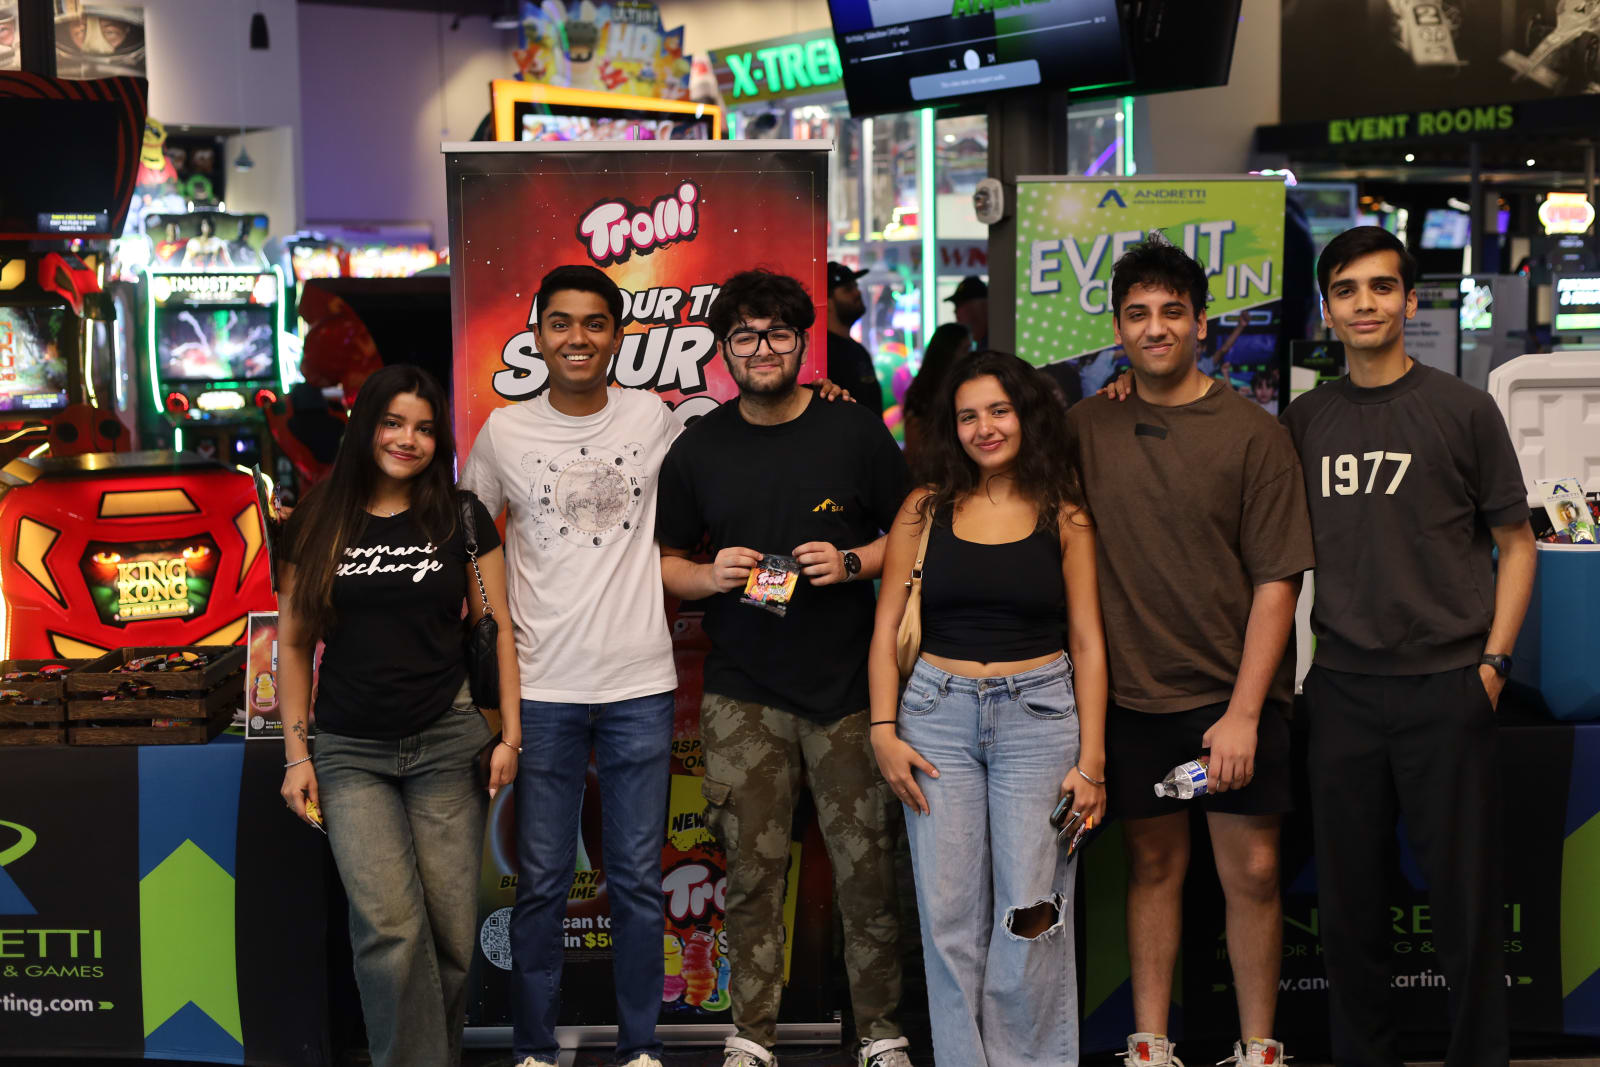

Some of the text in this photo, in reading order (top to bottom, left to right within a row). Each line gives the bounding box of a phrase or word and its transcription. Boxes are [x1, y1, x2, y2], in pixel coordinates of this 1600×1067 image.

[1328, 105, 1514, 144] EVENT ROOMS
[1134, 189, 1206, 199] ANDRETTI
[579, 182, 698, 261] Trolli
[1225, 260, 1272, 300] IN
[492, 325, 718, 398] SUR
[1321, 450, 1412, 498] 1977
[117, 558, 187, 582] KING
[117, 581, 188, 604] KONG
[562, 916, 594, 929] can
[584, 931, 613, 949] $5
[3, 964, 104, 978] & GAMES
[0, 992, 94, 1017] ting.com
